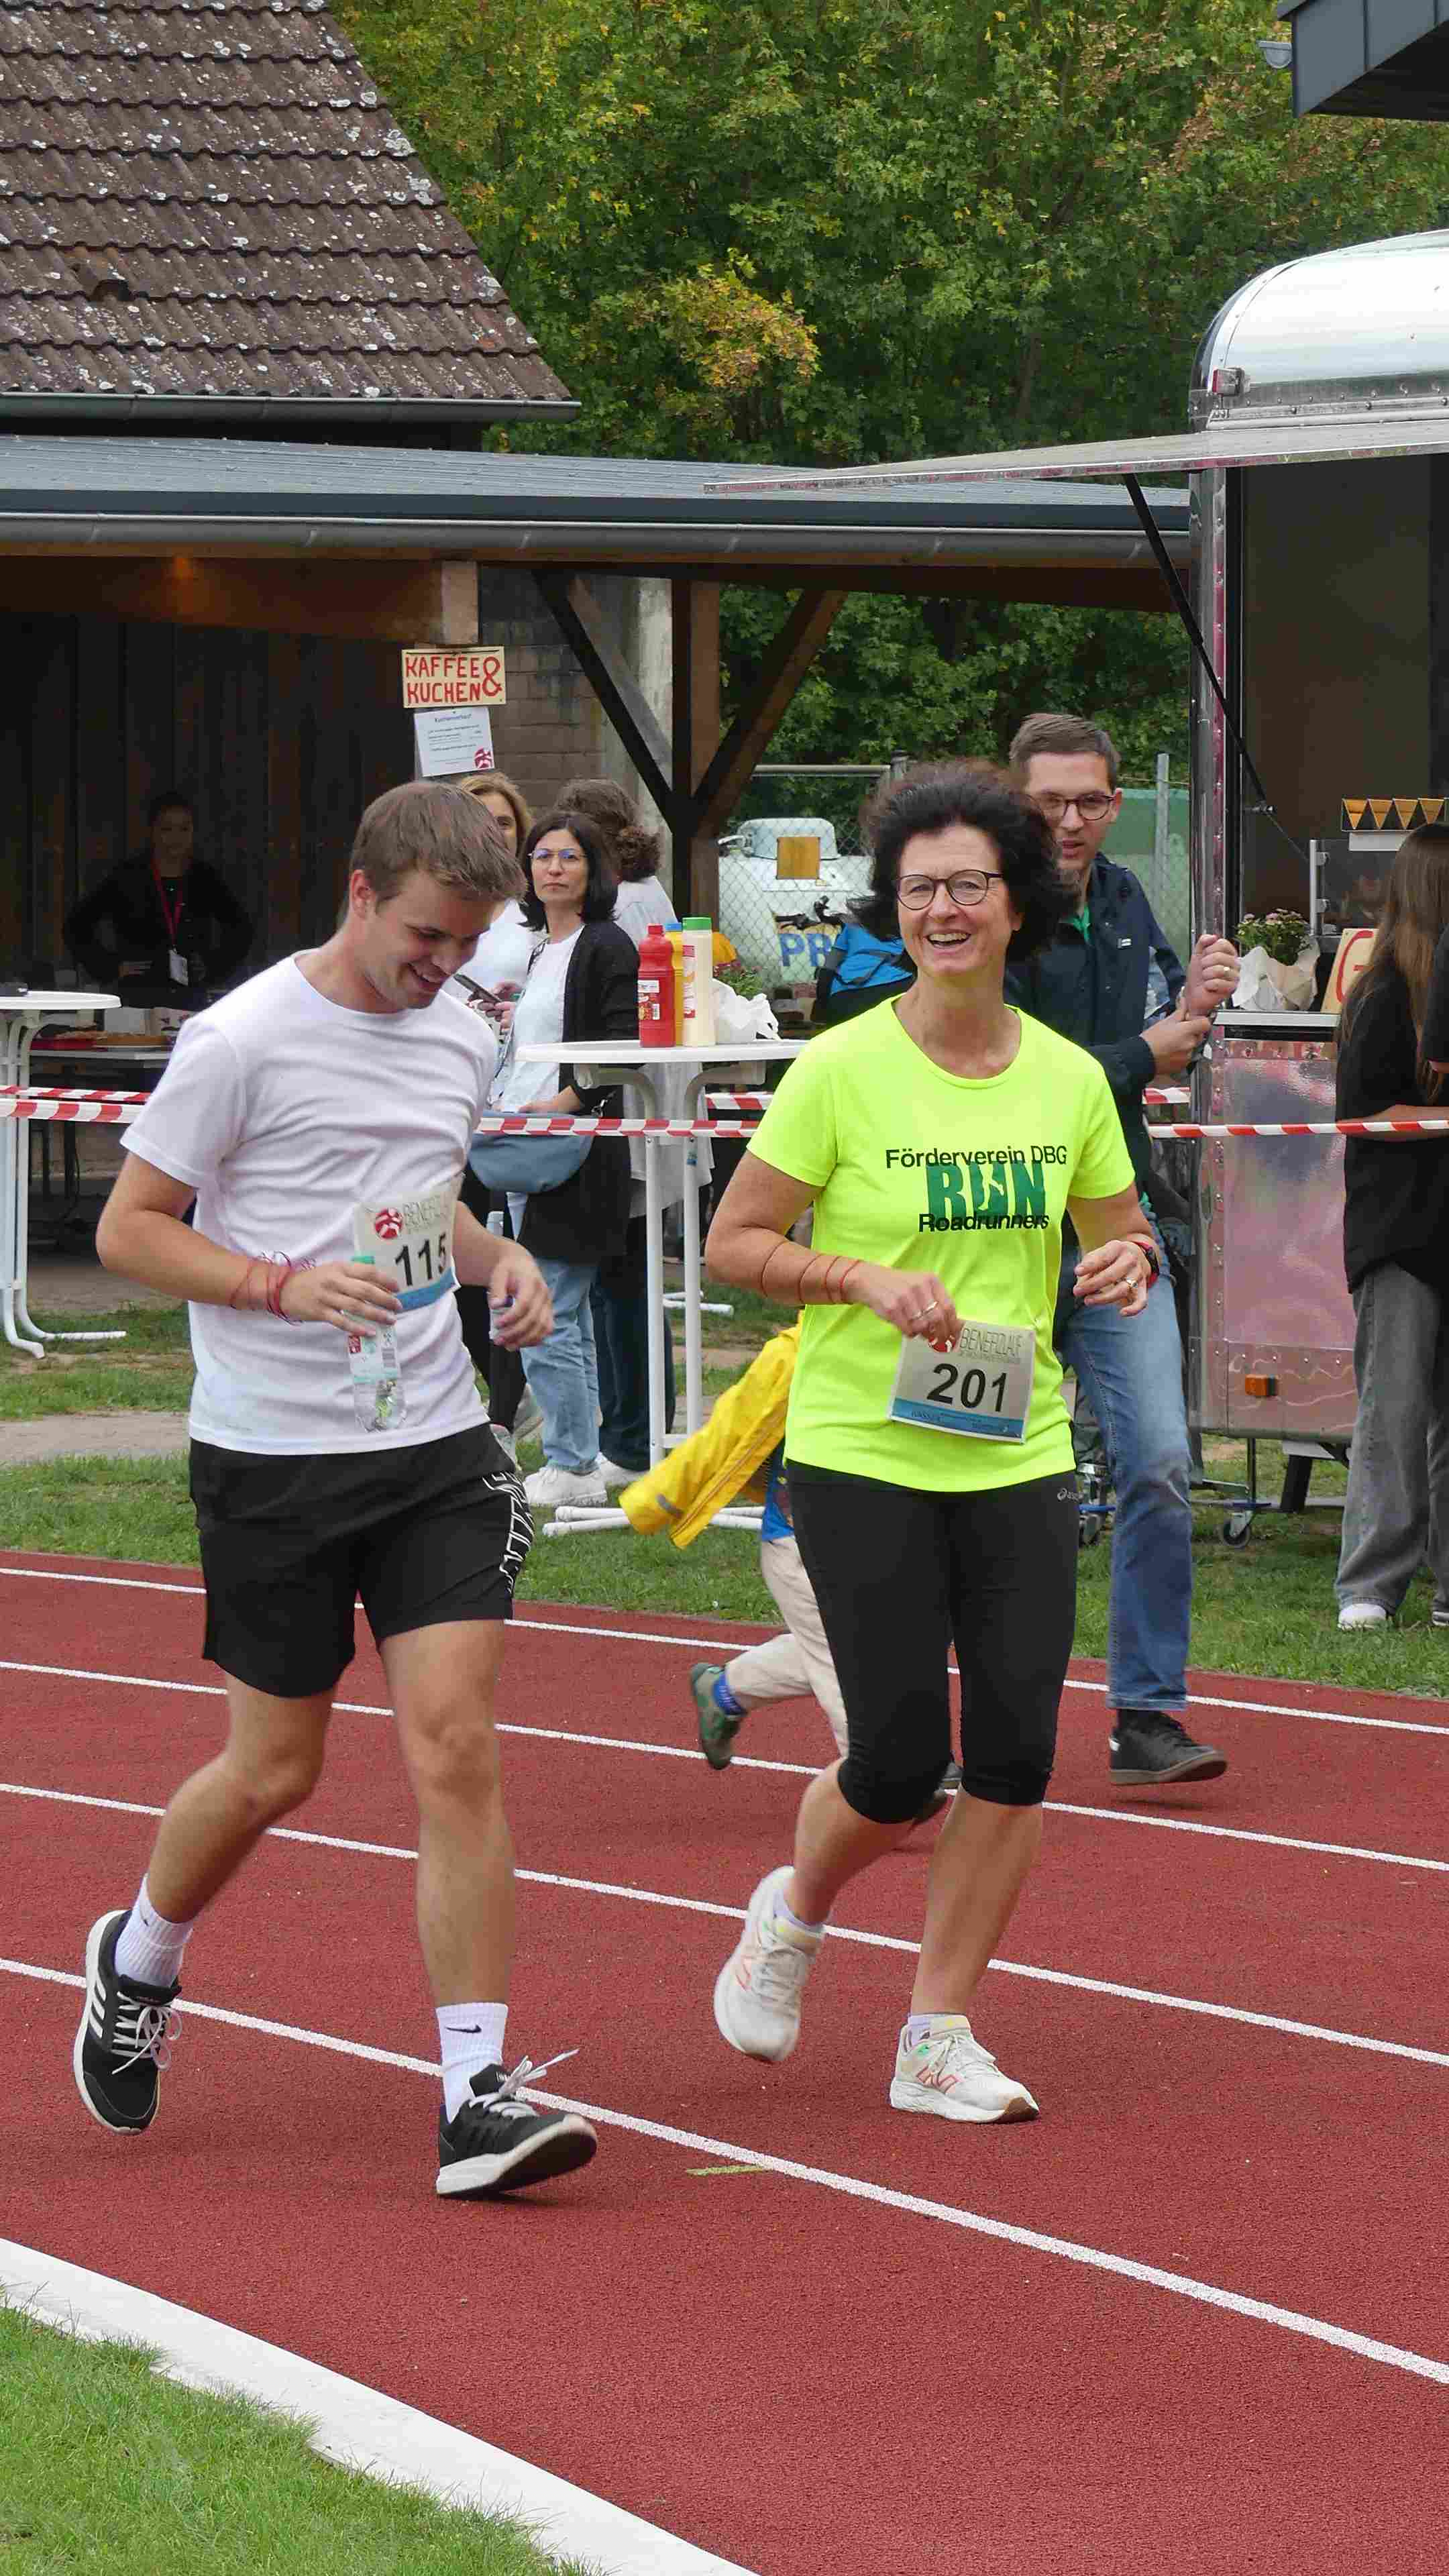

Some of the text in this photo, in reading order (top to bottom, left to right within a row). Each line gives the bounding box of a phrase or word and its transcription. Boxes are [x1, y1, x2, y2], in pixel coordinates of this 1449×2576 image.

[405, 655, 503, 696] KAFFEE &
[407, 682, 481, 704] KUCHEN
[885, 1145, 1068, 1169] Förderverein DBG
[918, 1212, 1050, 1233] Roadrunners
[394, 1231, 446, 1286] 115
[926, 1363, 1007, 1412] 201
